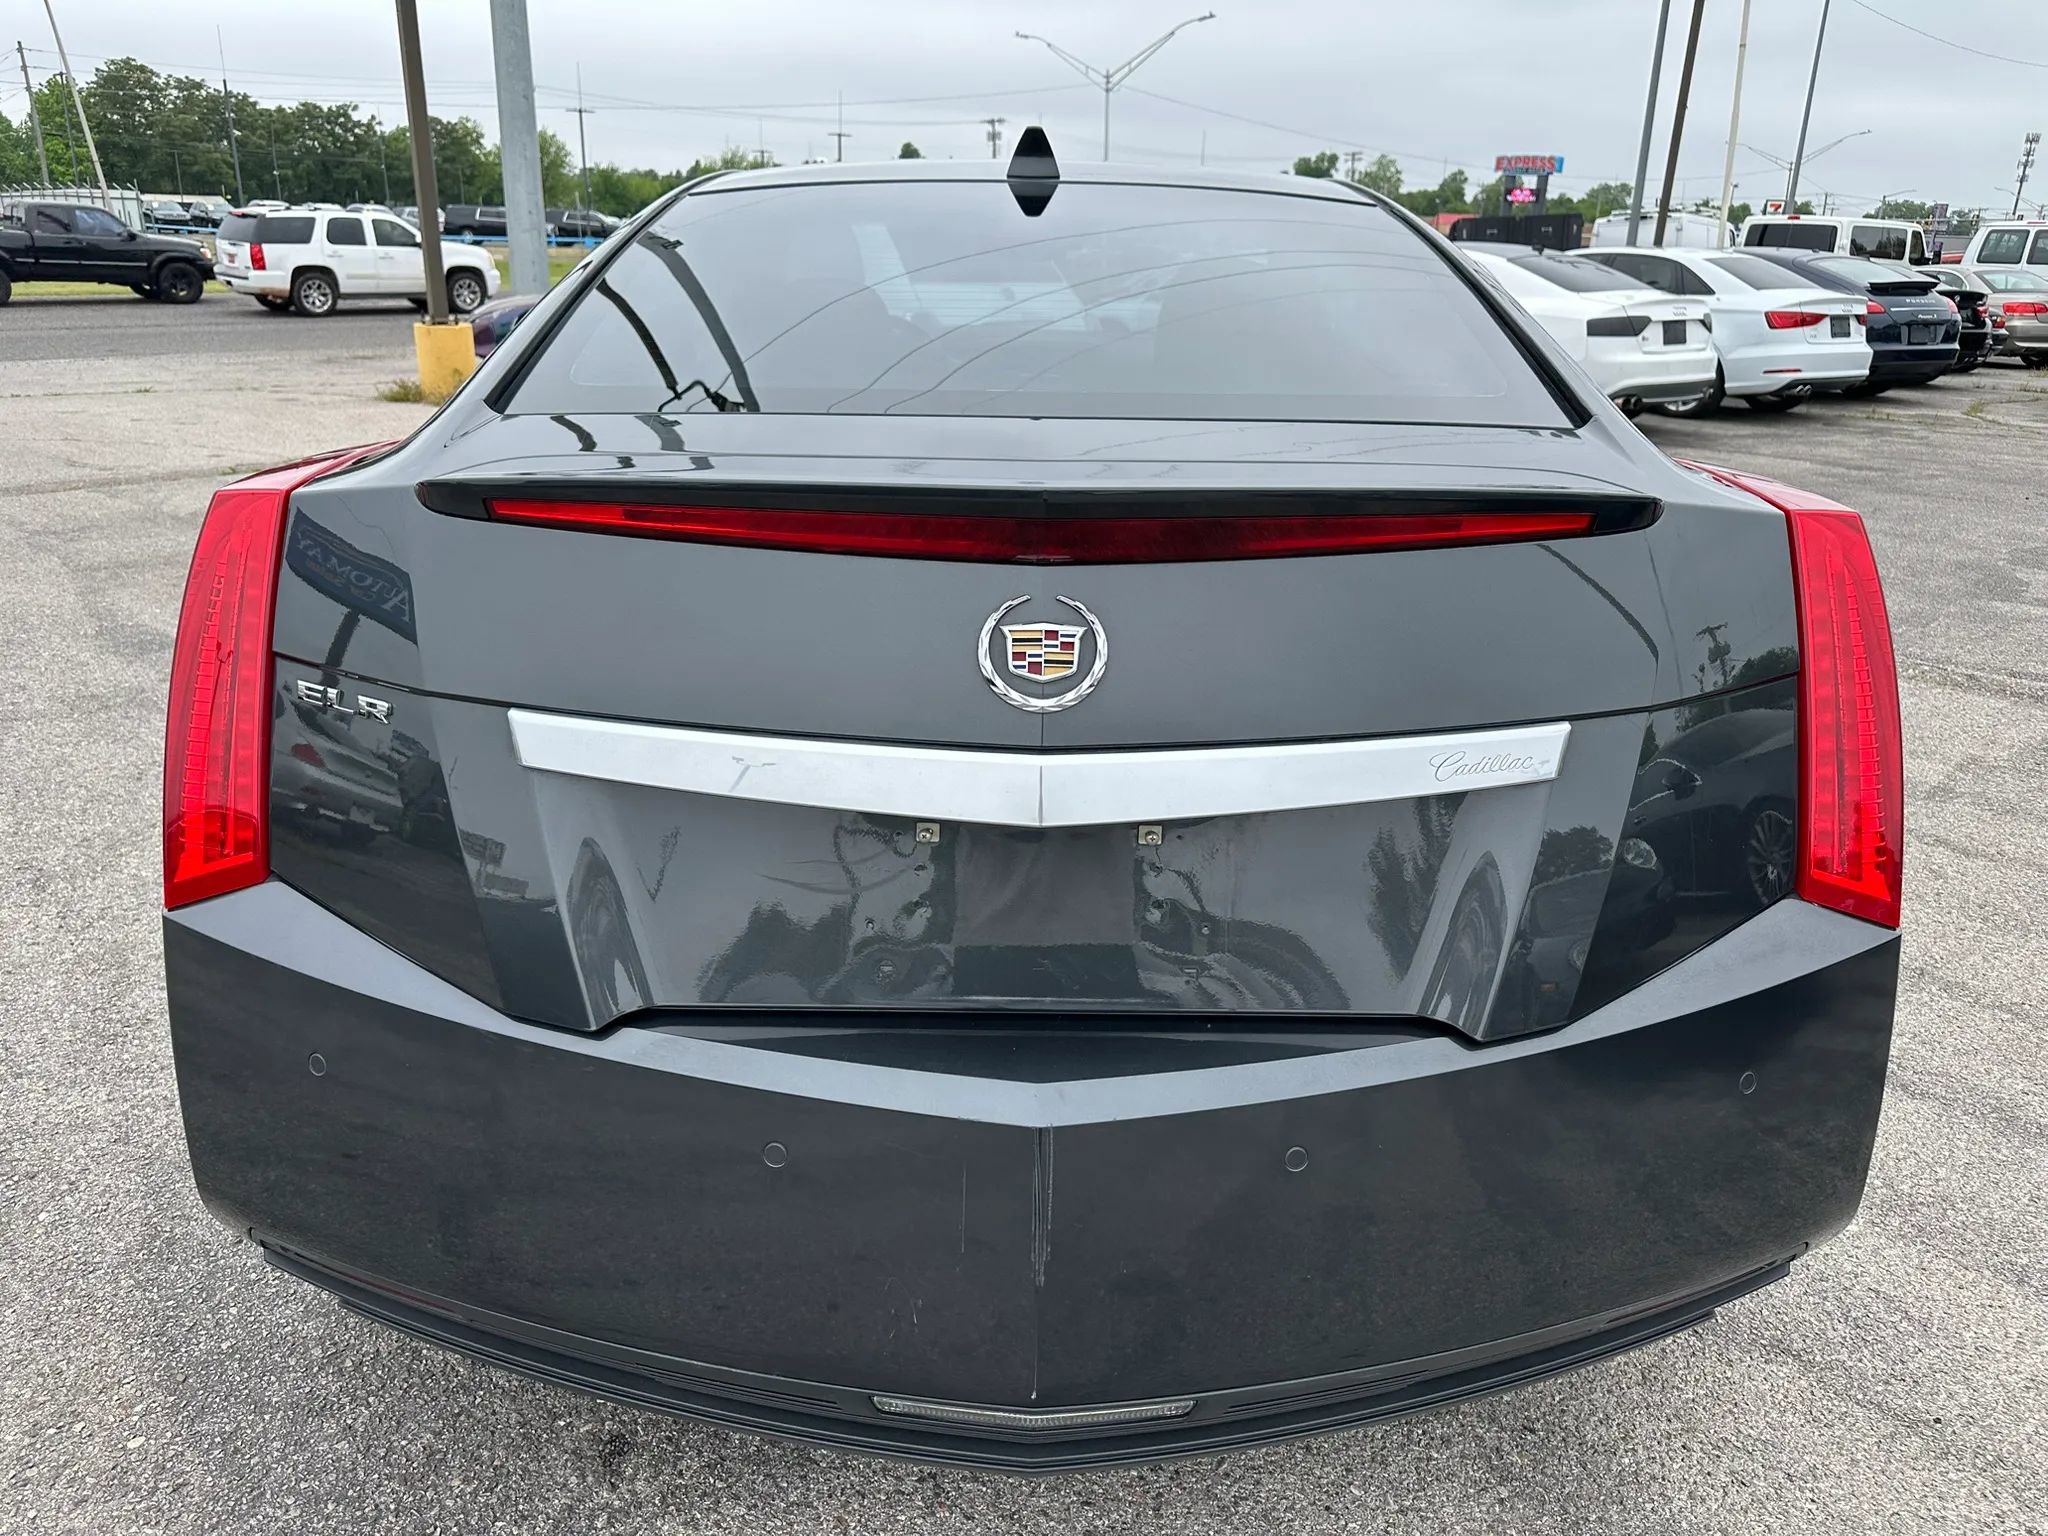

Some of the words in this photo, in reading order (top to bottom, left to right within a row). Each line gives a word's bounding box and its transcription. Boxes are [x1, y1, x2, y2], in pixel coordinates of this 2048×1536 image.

[1495, 155, 1556, 172] EXPRESS
[297, 680, 393, 724] ELR
[1429, 751, 1535, 783] Cadillac
